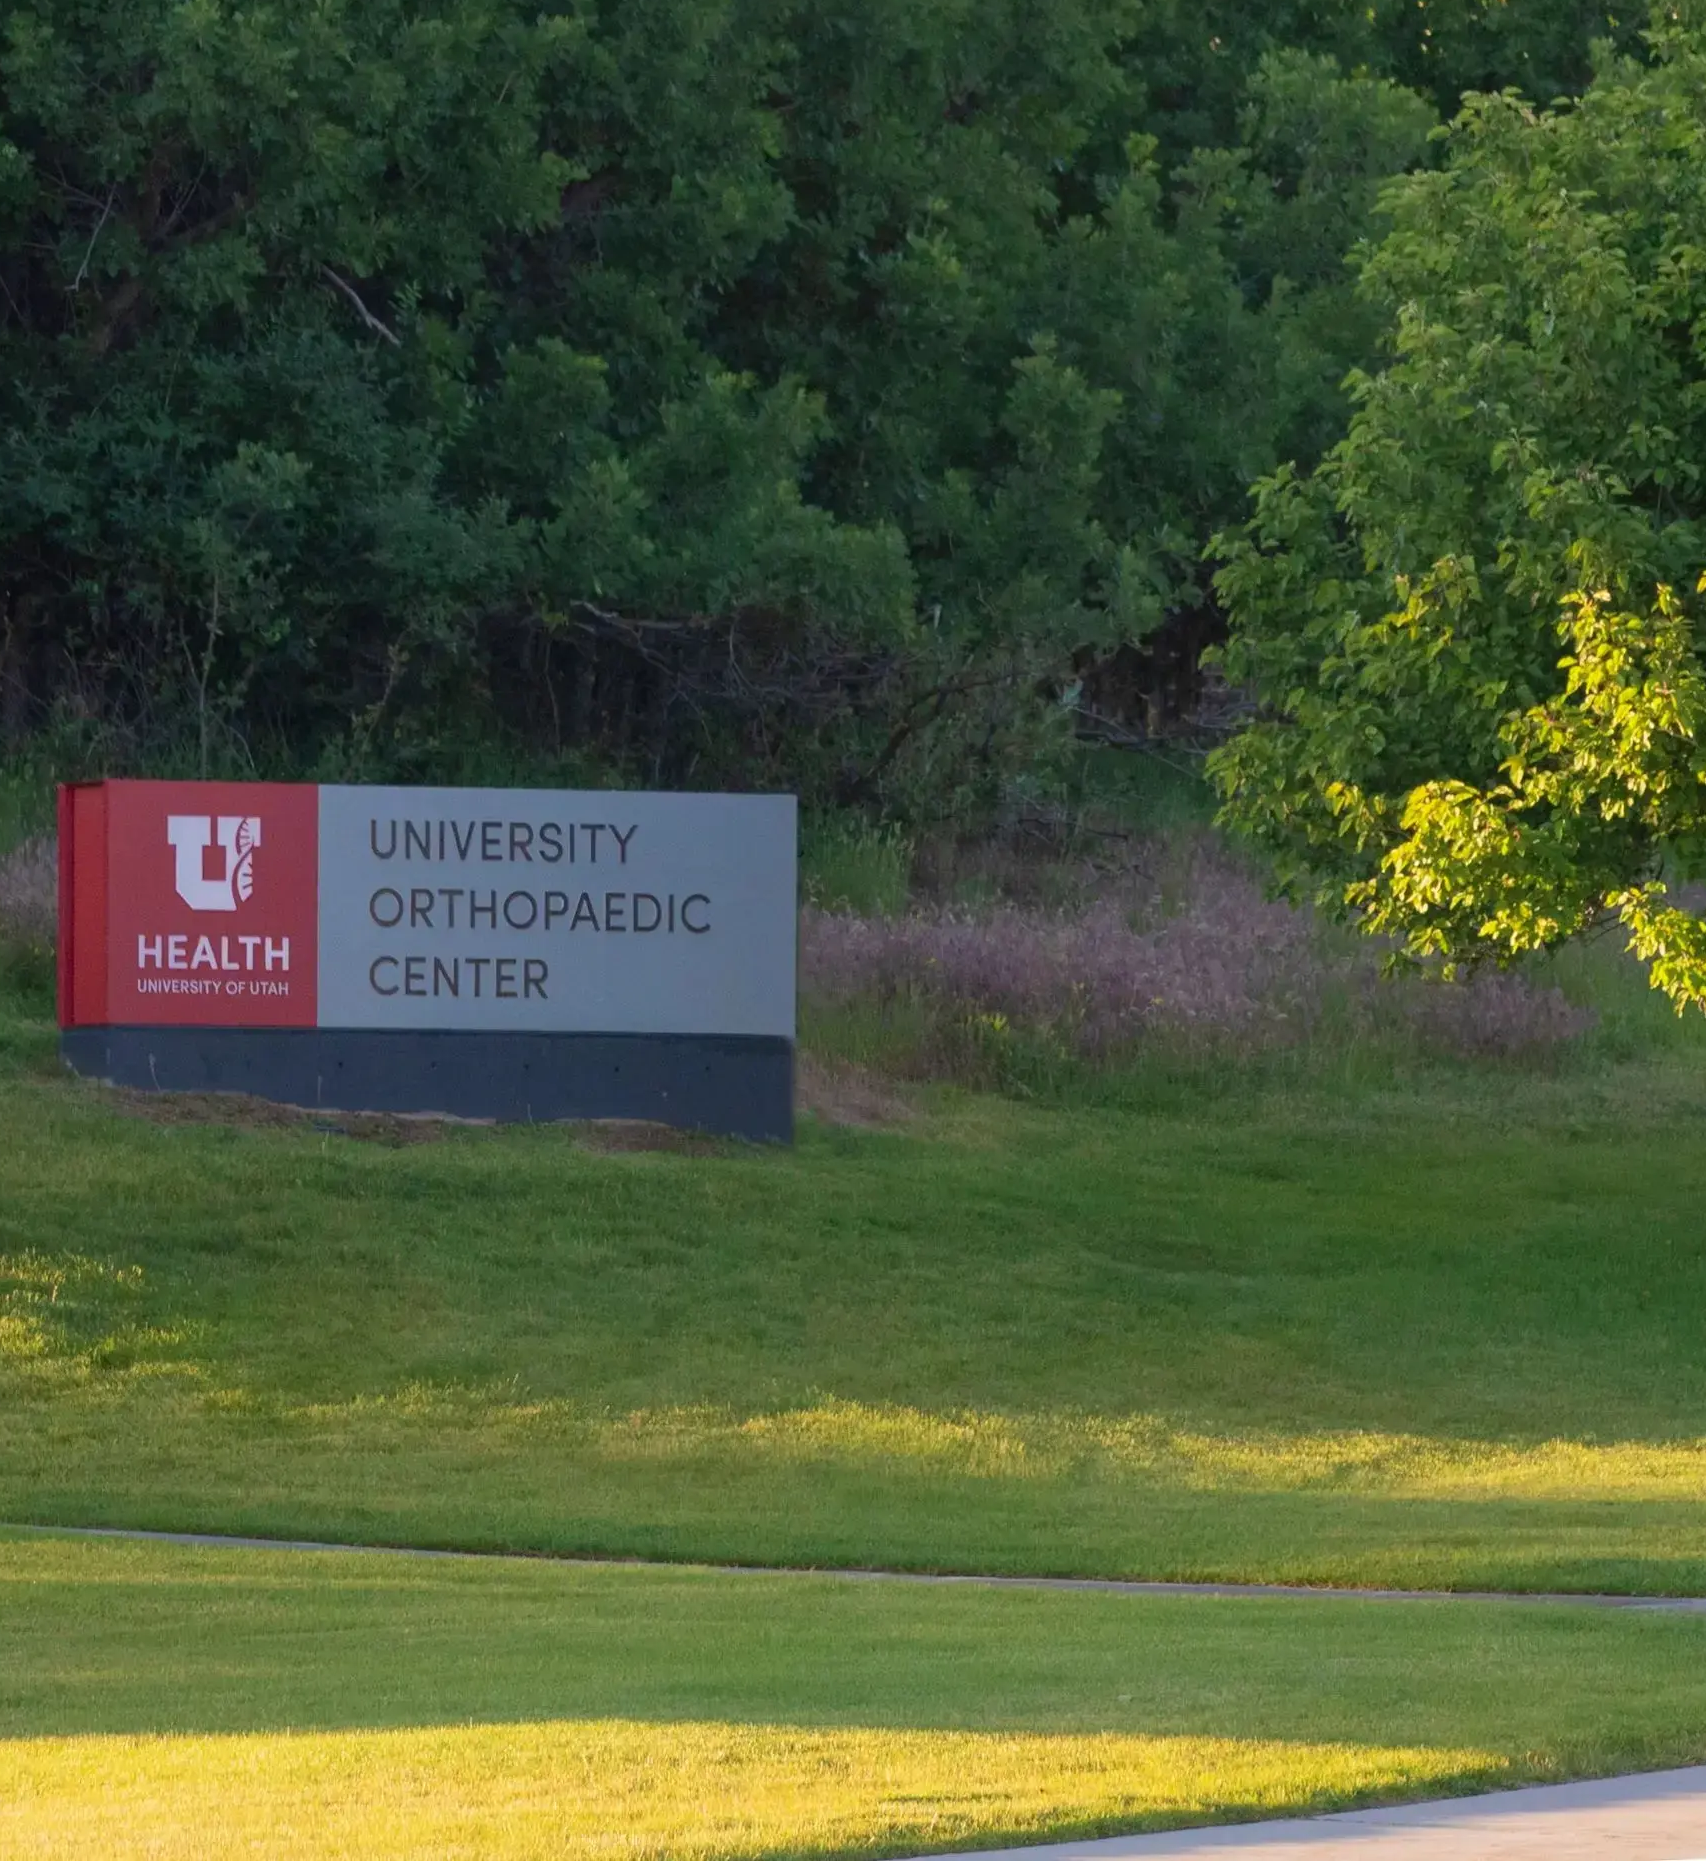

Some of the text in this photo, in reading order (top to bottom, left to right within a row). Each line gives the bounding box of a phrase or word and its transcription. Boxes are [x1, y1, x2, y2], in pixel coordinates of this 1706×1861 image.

[370, 818, 639, 864] UNIVERSITY
[369, 887, 712, 935] ORTHOPAEDIC
[137, 933, 290, 971] HEALTH
[137, 978, 289, 996] UNIVERSITY OF UTAH
[369, 955, 549, 999] CENTER
